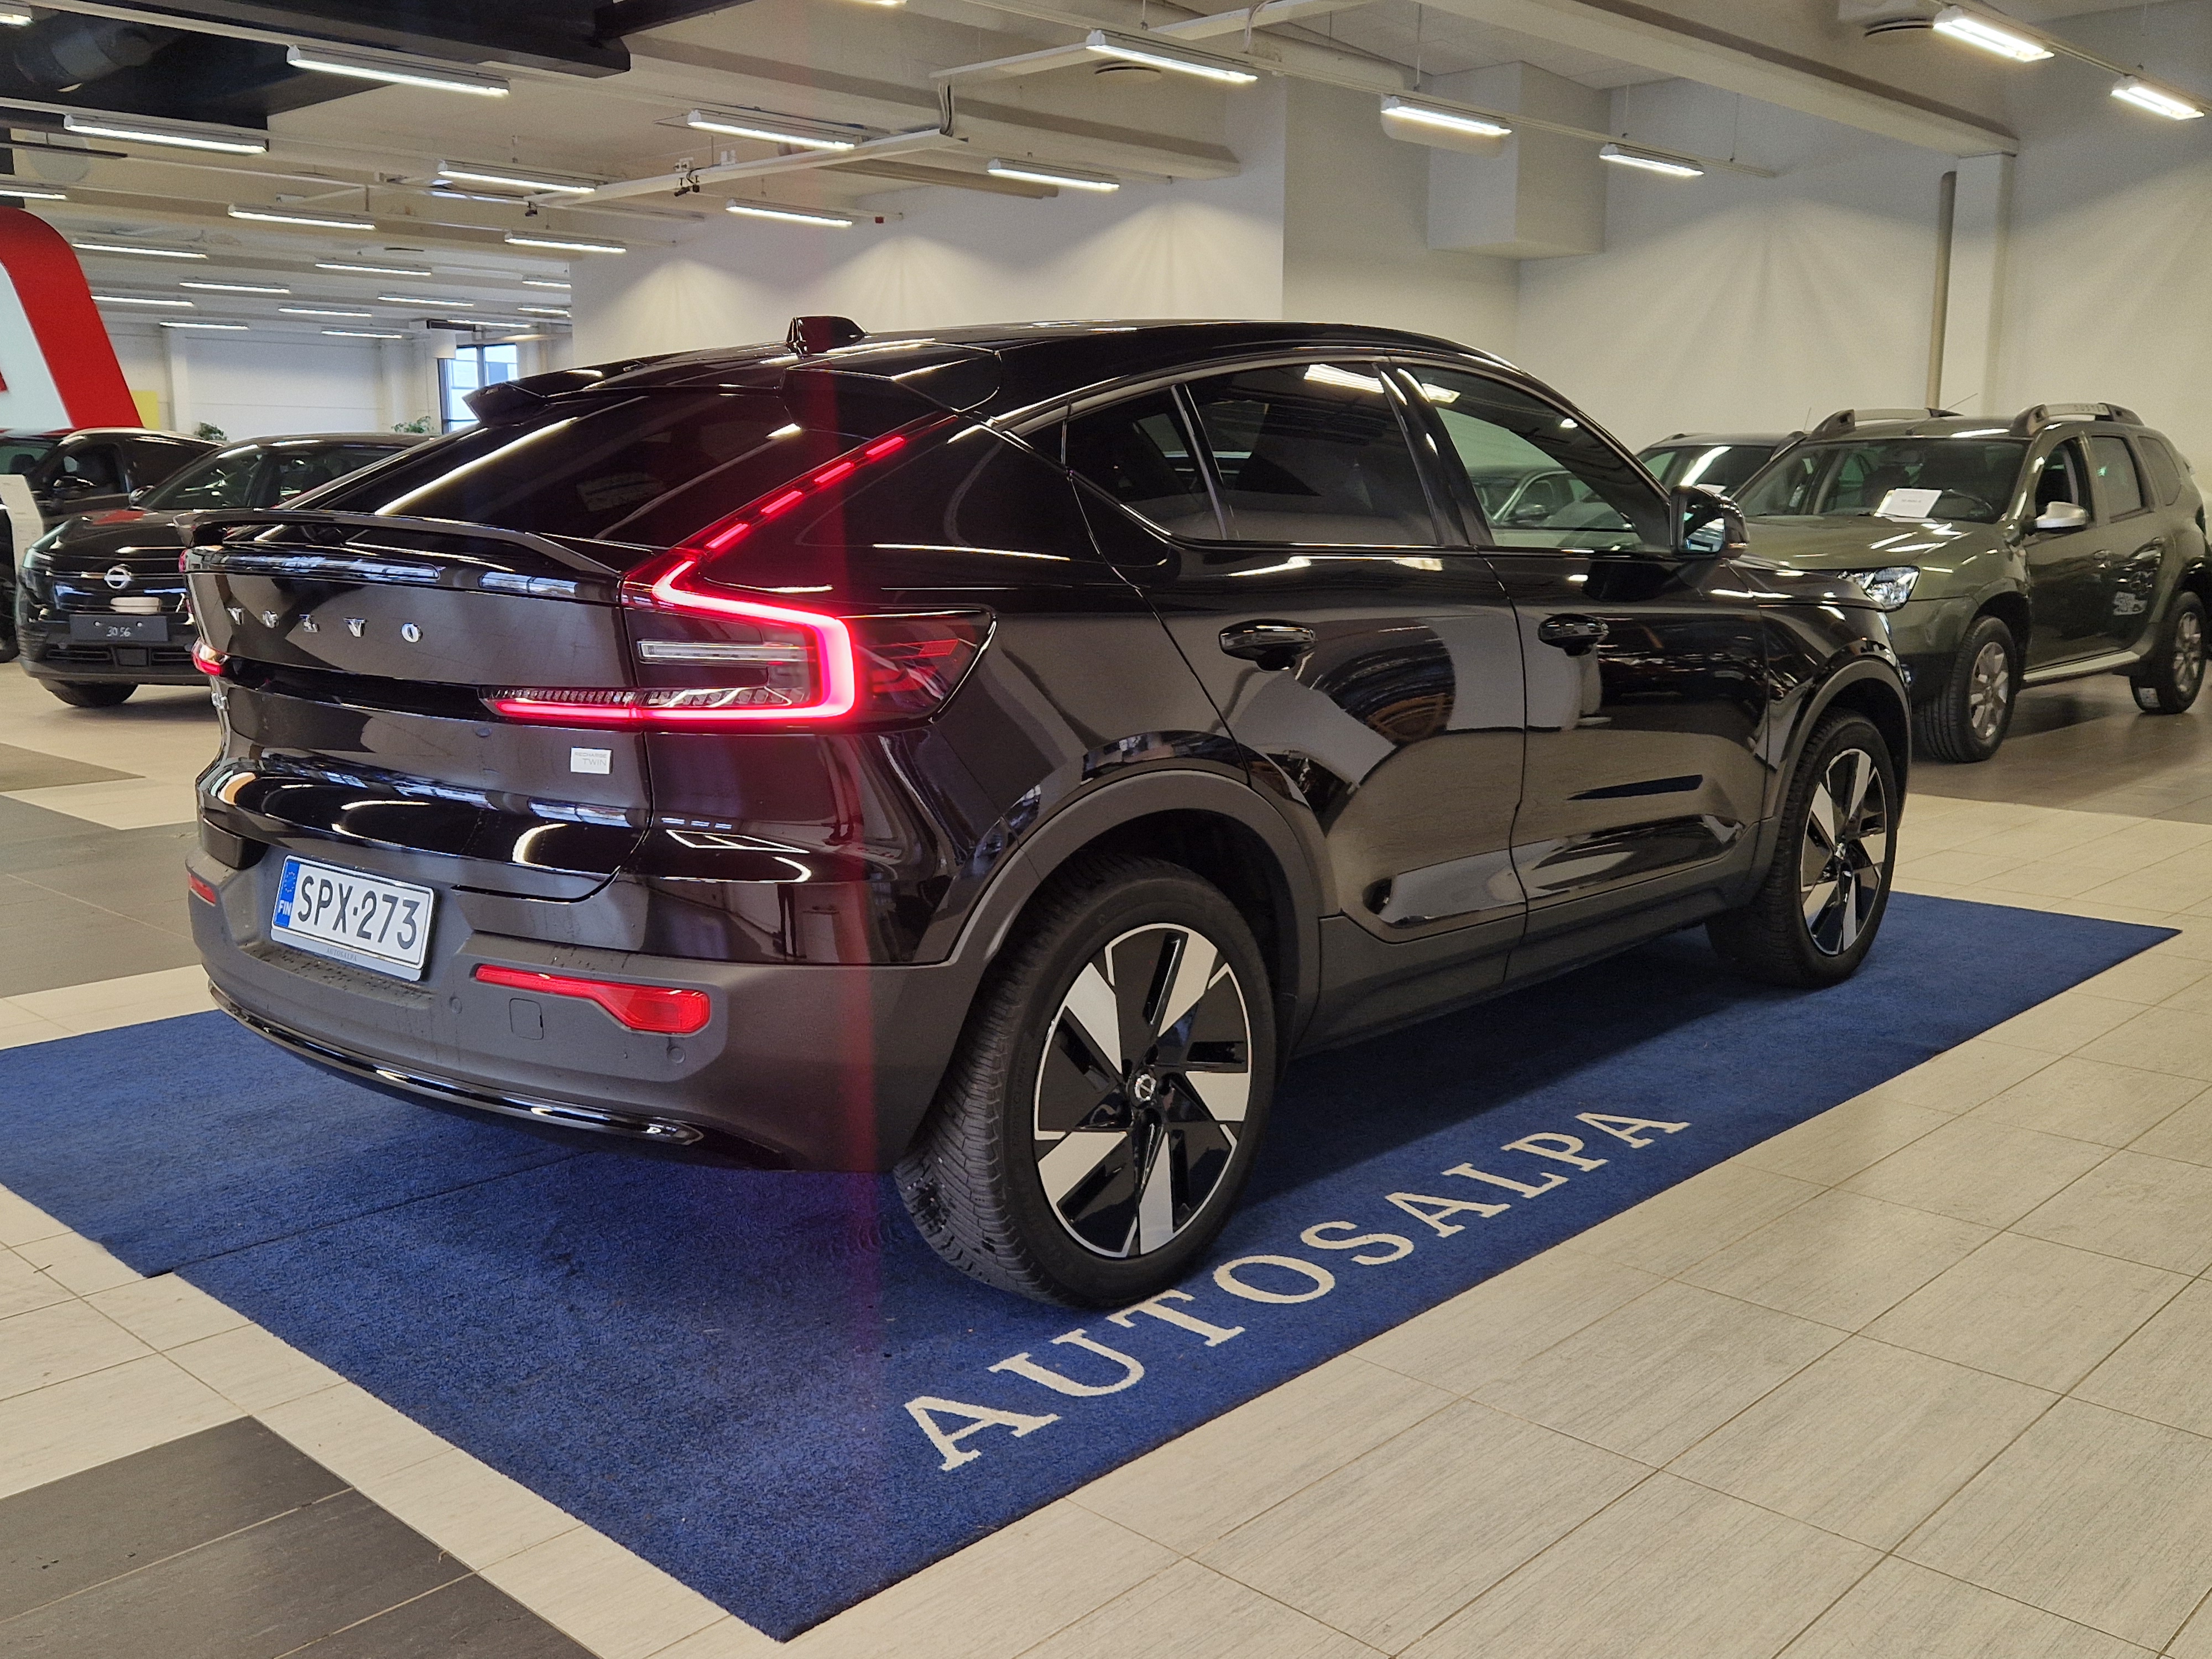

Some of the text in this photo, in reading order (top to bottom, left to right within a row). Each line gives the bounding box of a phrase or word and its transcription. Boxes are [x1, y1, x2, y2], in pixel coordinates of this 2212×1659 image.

[227, 607, 424, 643] VOLVO
[278, 899, 292, 916] FIN
[298, 875, 420, 950] SPX-273
[904, 1111, 1691, 1472] AUTOSALPA
